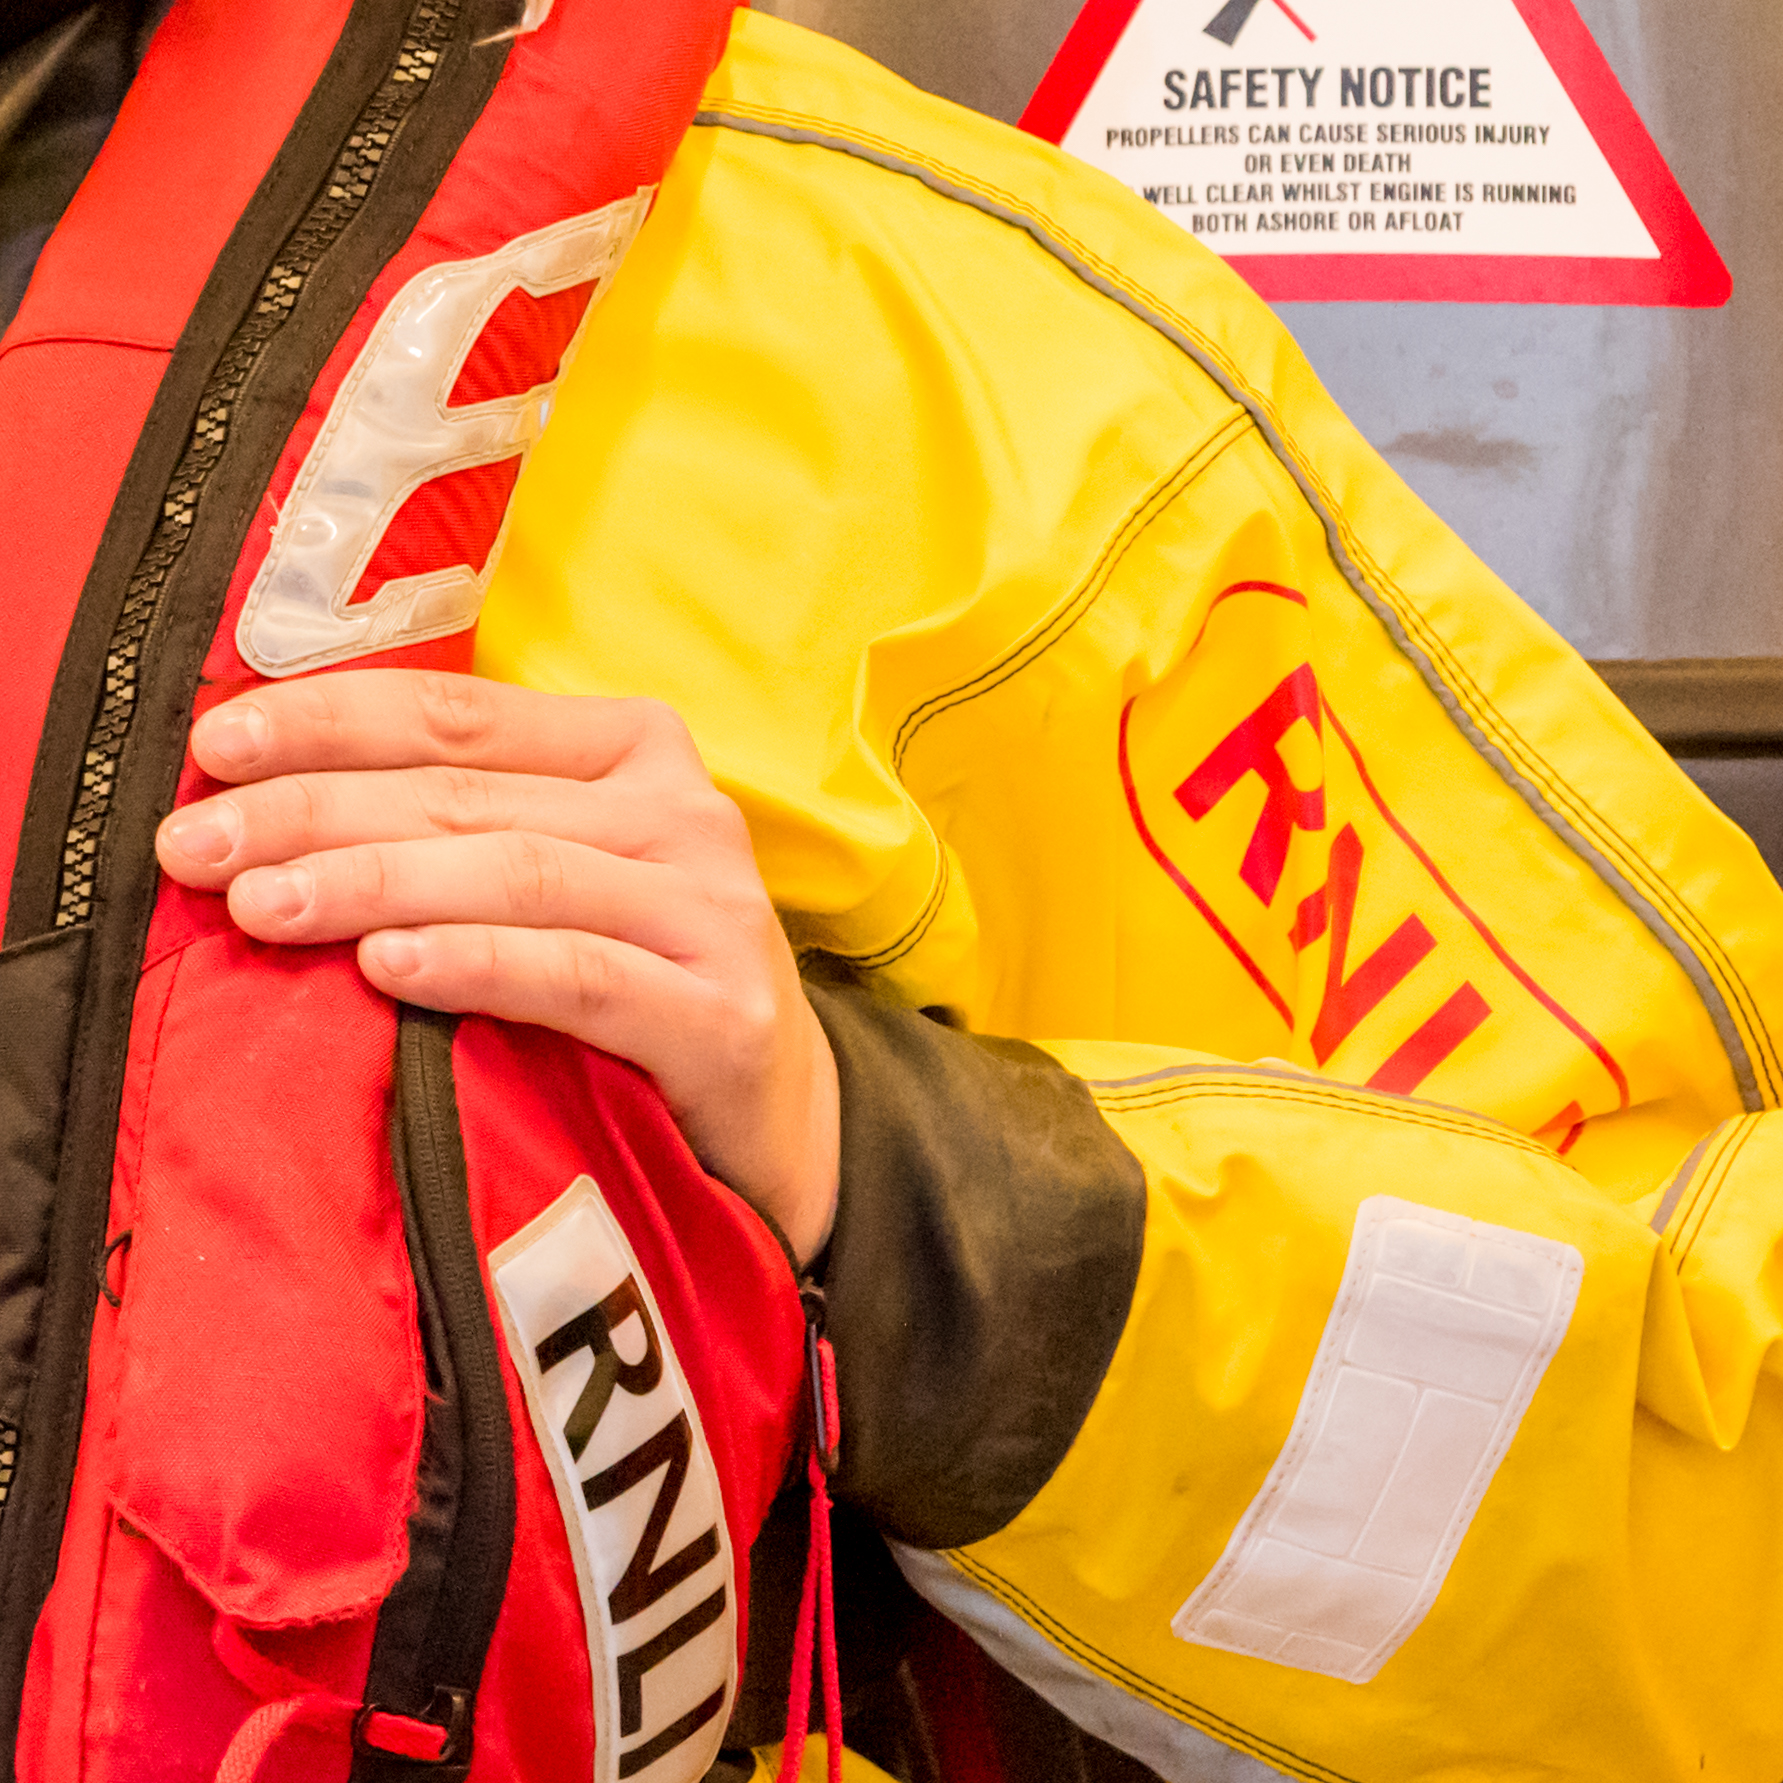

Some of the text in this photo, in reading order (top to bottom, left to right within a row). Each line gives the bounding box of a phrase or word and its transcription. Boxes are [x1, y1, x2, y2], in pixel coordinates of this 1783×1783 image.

[1163, 66, 1492, 111] SAFETY NOTICE
[1106, 123, 1551, 150] PROPELLERS CAN CAUSE SERIOUS INJURY
[1245, 152, 1412, 174] OR EVEN DEATH
[1142, 182, 1578, 205] WELL CLEAR WHILST ENGINE IS RUNNING
[1192, 211, 1465, 234] BOTH ASHORE OR AFLOAT
[534, 1272, 728, 1779] RNLI
